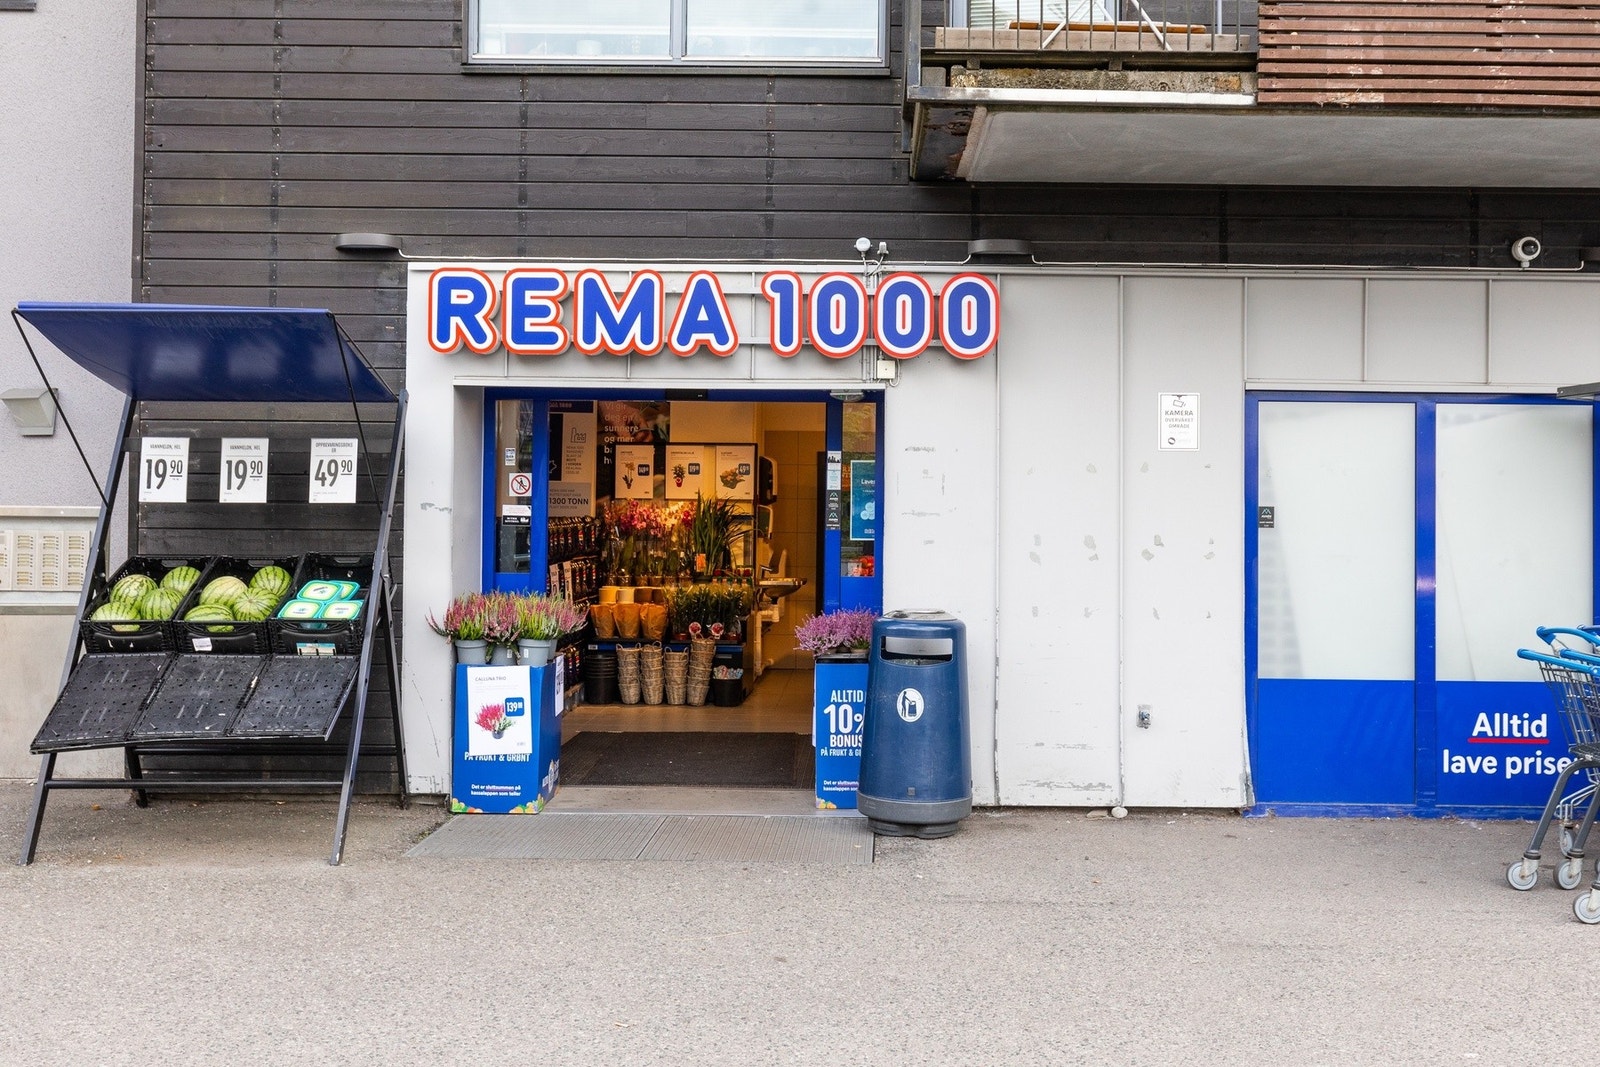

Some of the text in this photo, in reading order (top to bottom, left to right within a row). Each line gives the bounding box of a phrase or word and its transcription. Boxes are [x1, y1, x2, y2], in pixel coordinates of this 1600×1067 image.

[428, 267, 1001, 359] REMA 1000
[604, 436, 615, 444] og
[145, 458, 168, 490] 19
[225, 459, 248, 491] 19
[314, 458, 339, 487] 49
[549, 497, 589, 505] 1300 TONN
[506, 701, 518, 713] 139
[830, 689, 864, 703] ALLTID
[1471, 712, 1548, 738] Alltid
[821, 747, 828, 756] PÅ
[829, 748, 847, 757] FRUKT
[848, 749, 854, 757] &
[1442, 748, 1498, 774] lave
